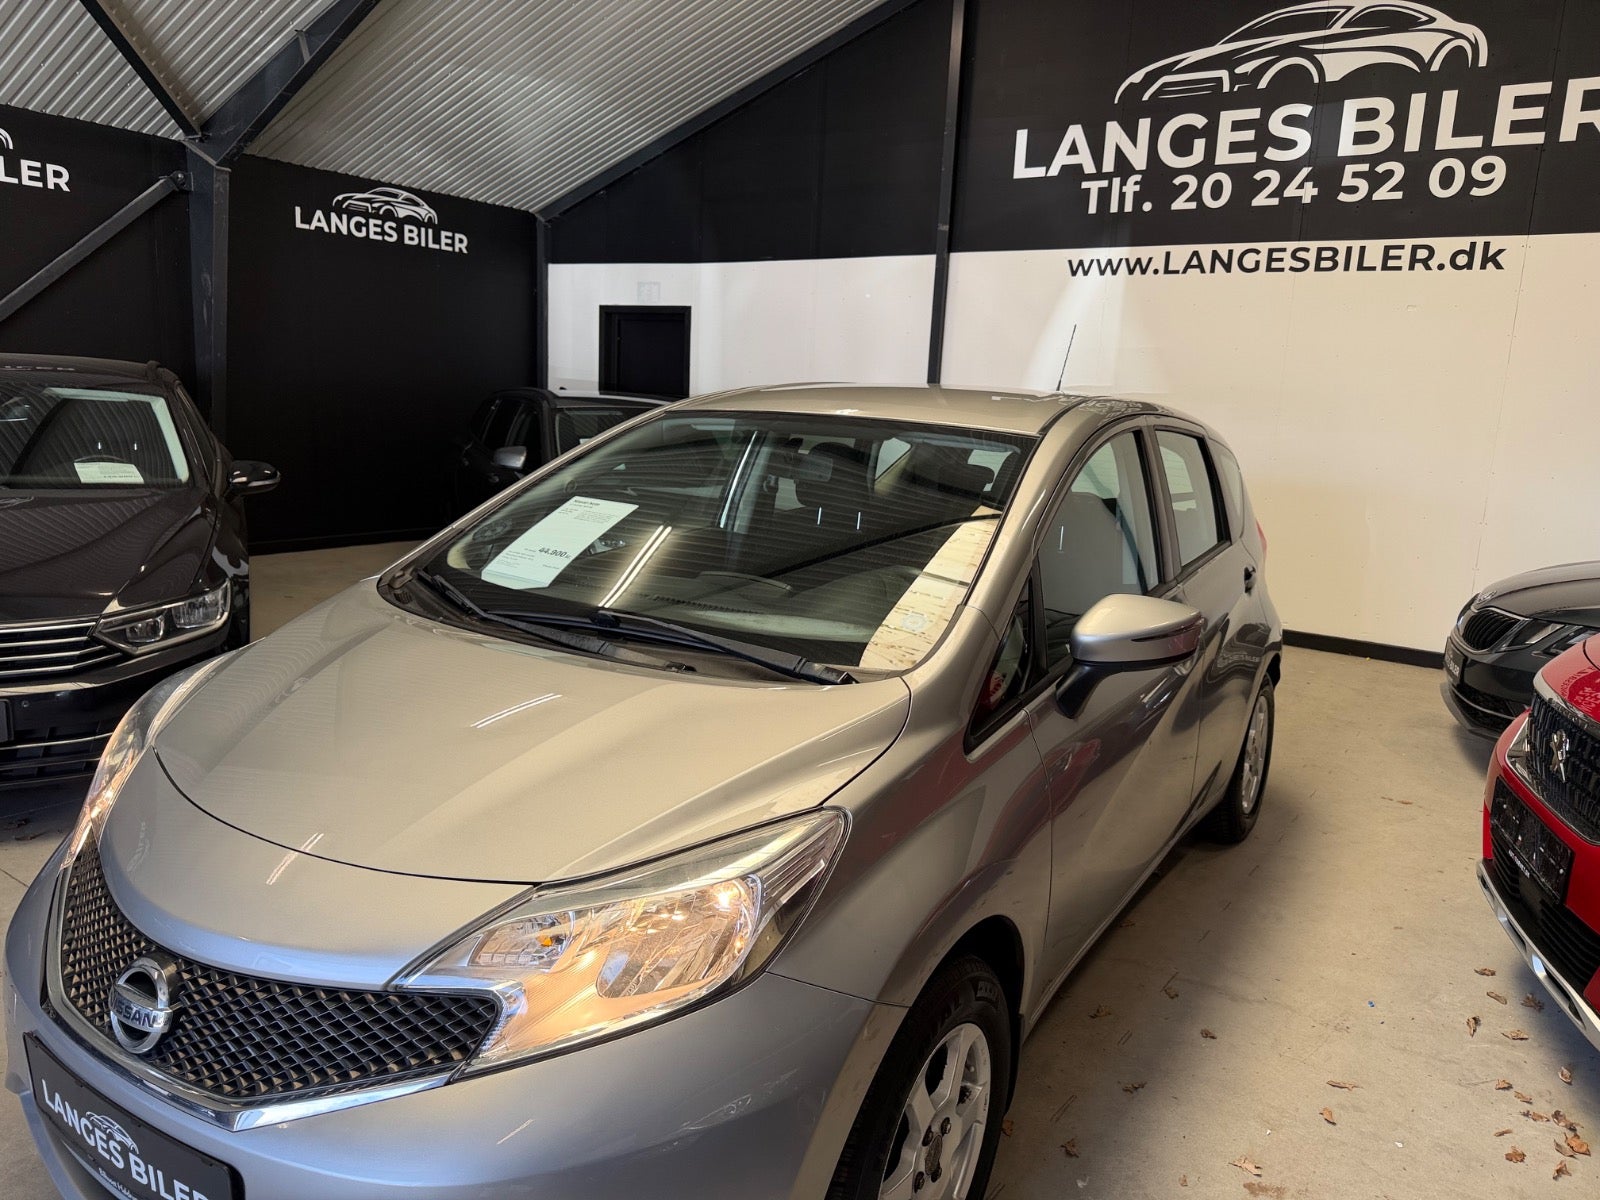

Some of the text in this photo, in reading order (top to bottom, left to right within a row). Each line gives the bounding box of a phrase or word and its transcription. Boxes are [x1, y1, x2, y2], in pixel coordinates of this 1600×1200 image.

[1012, 102, 1313, 179] LANGES
[1080, 155, 1507, 215] Tlf. 20 24 52 09
[294, 205, 469, 254] LANGES BILER
[1067, 241, 1507, 277] www.LANGESBILER.dk
[41, 1079, 125, 1169] LANGES
